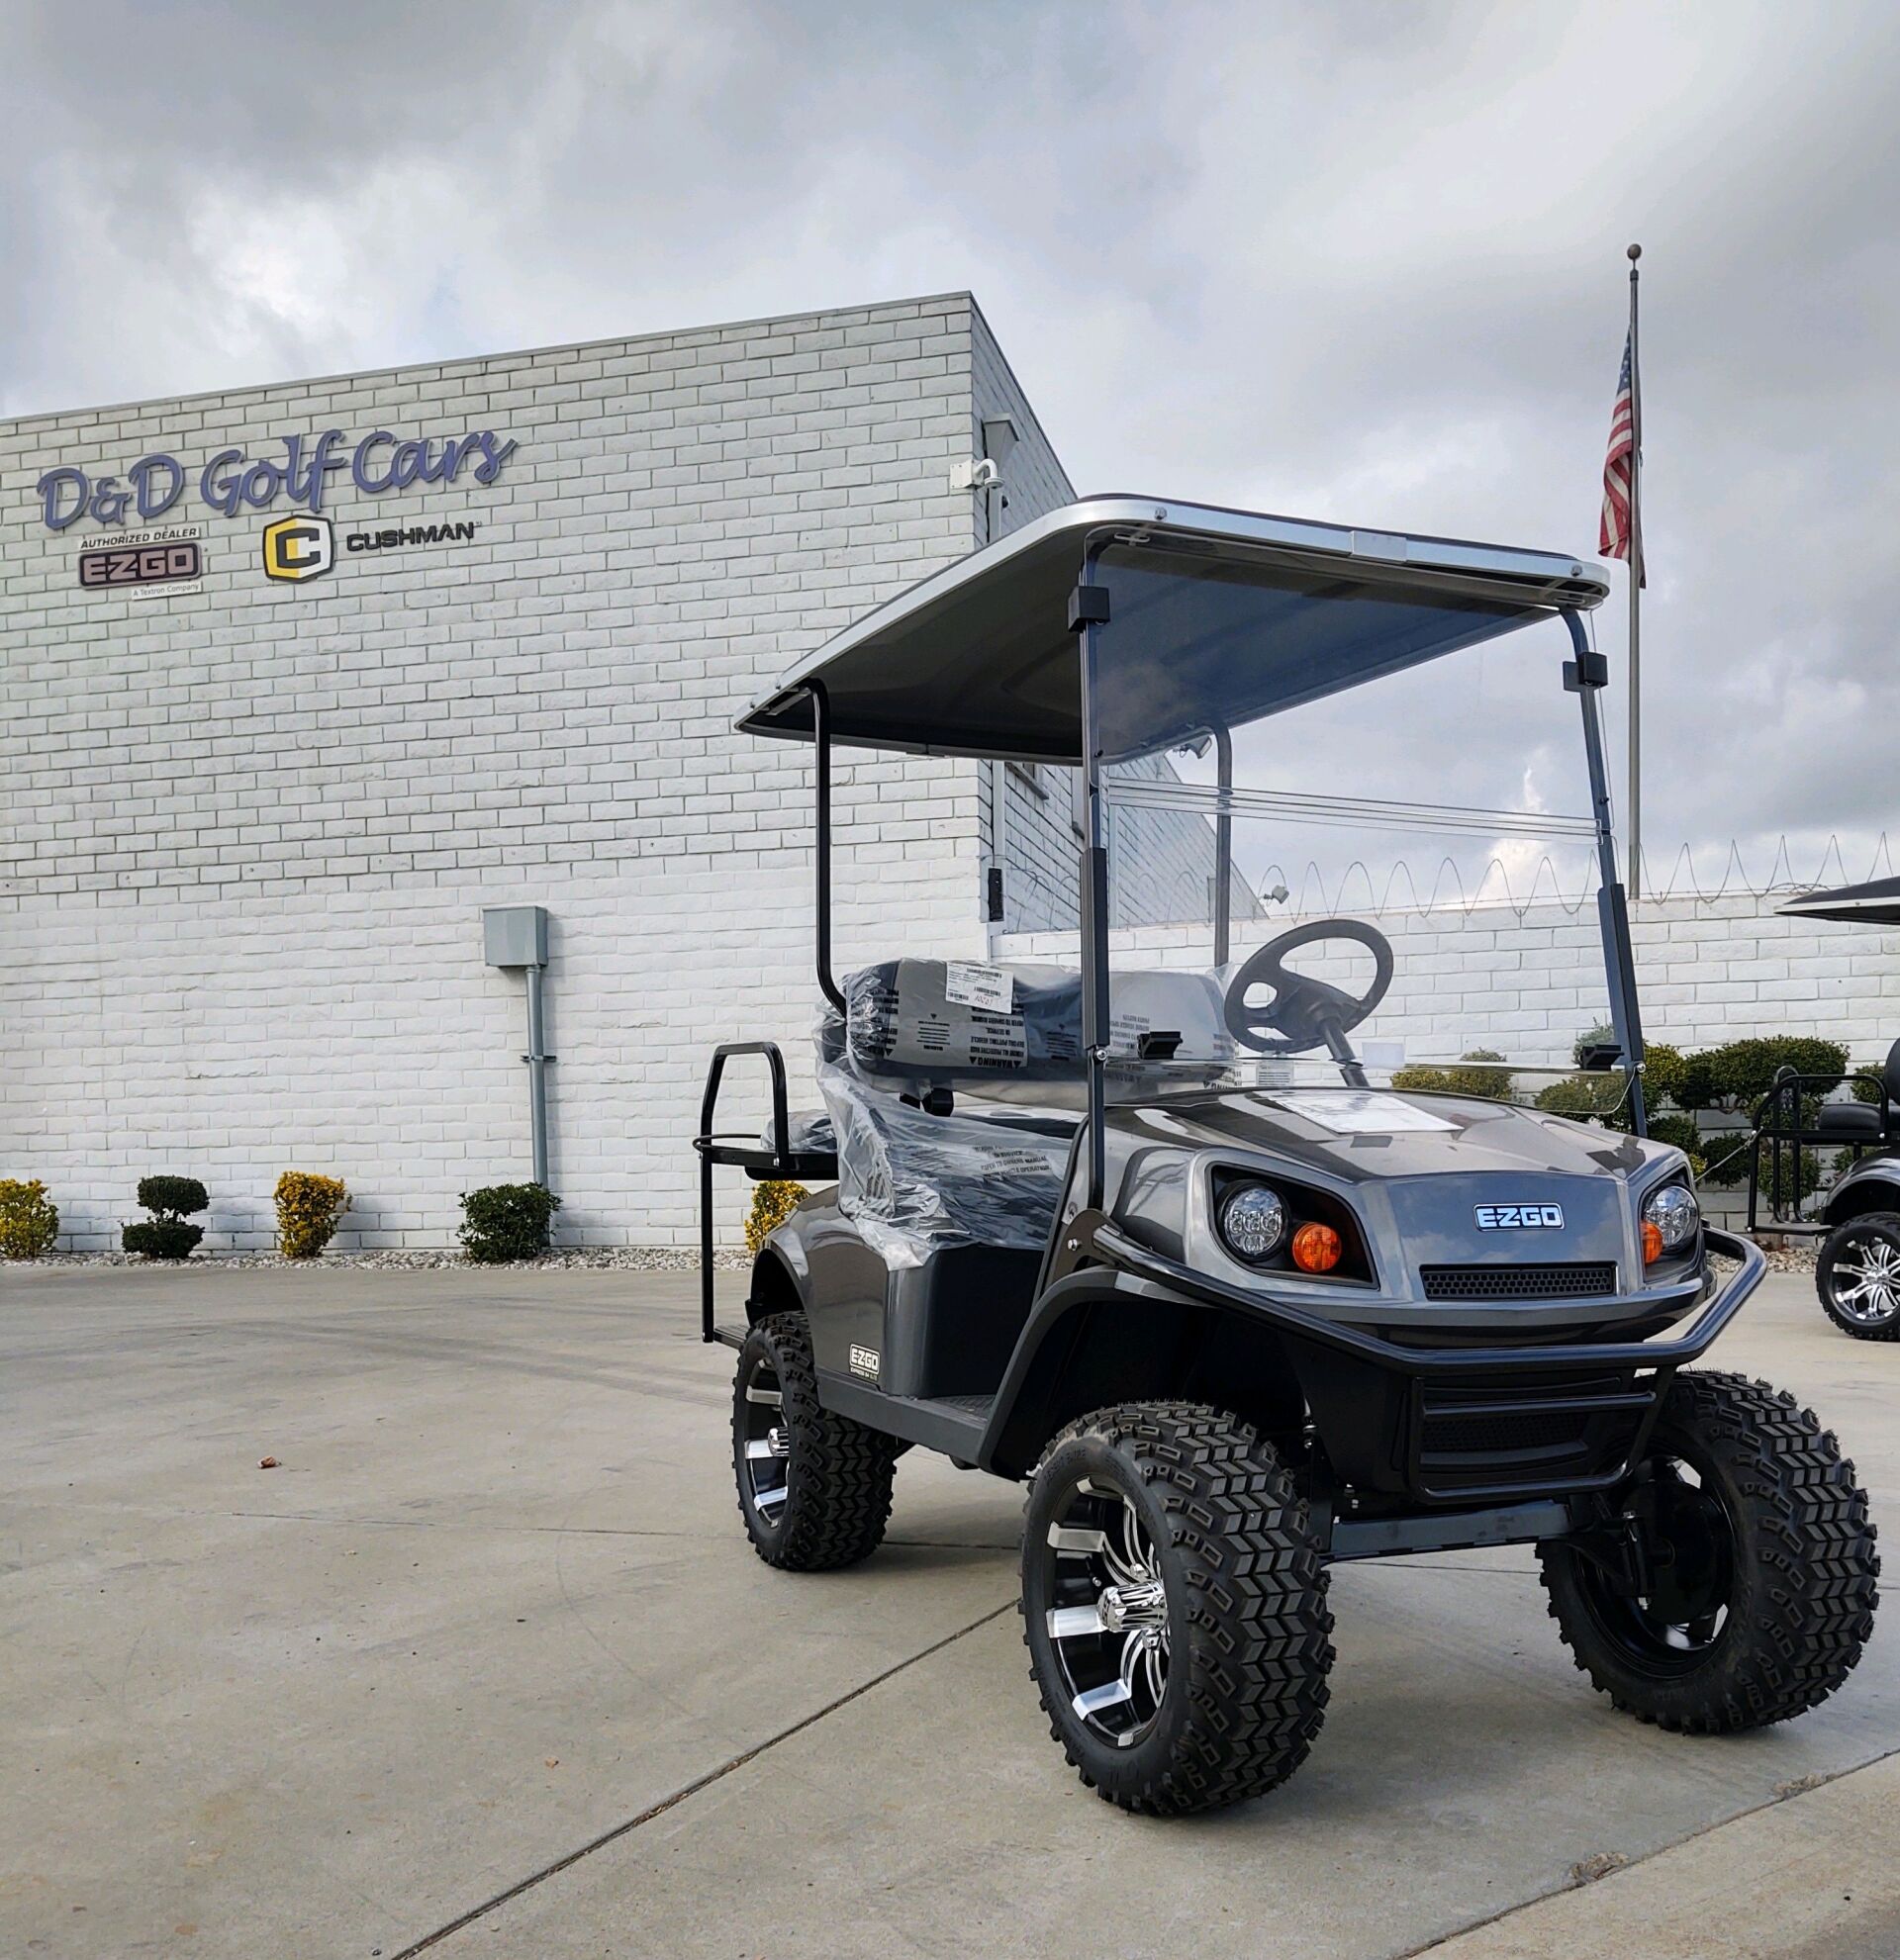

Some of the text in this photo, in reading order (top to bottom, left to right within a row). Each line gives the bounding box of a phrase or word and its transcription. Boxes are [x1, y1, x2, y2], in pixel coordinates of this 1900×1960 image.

[37, 429, 518, 530] D&D Golf Cars
[81, 528, 197, 549] AUTHORIZED DEALER
[346, 521, 474, 552] CUSHMAN
[141, 587, 165, 596] Textron
[167, 583, 199, 596] Company
[978, 1057, 1013, 1069] WARNING
